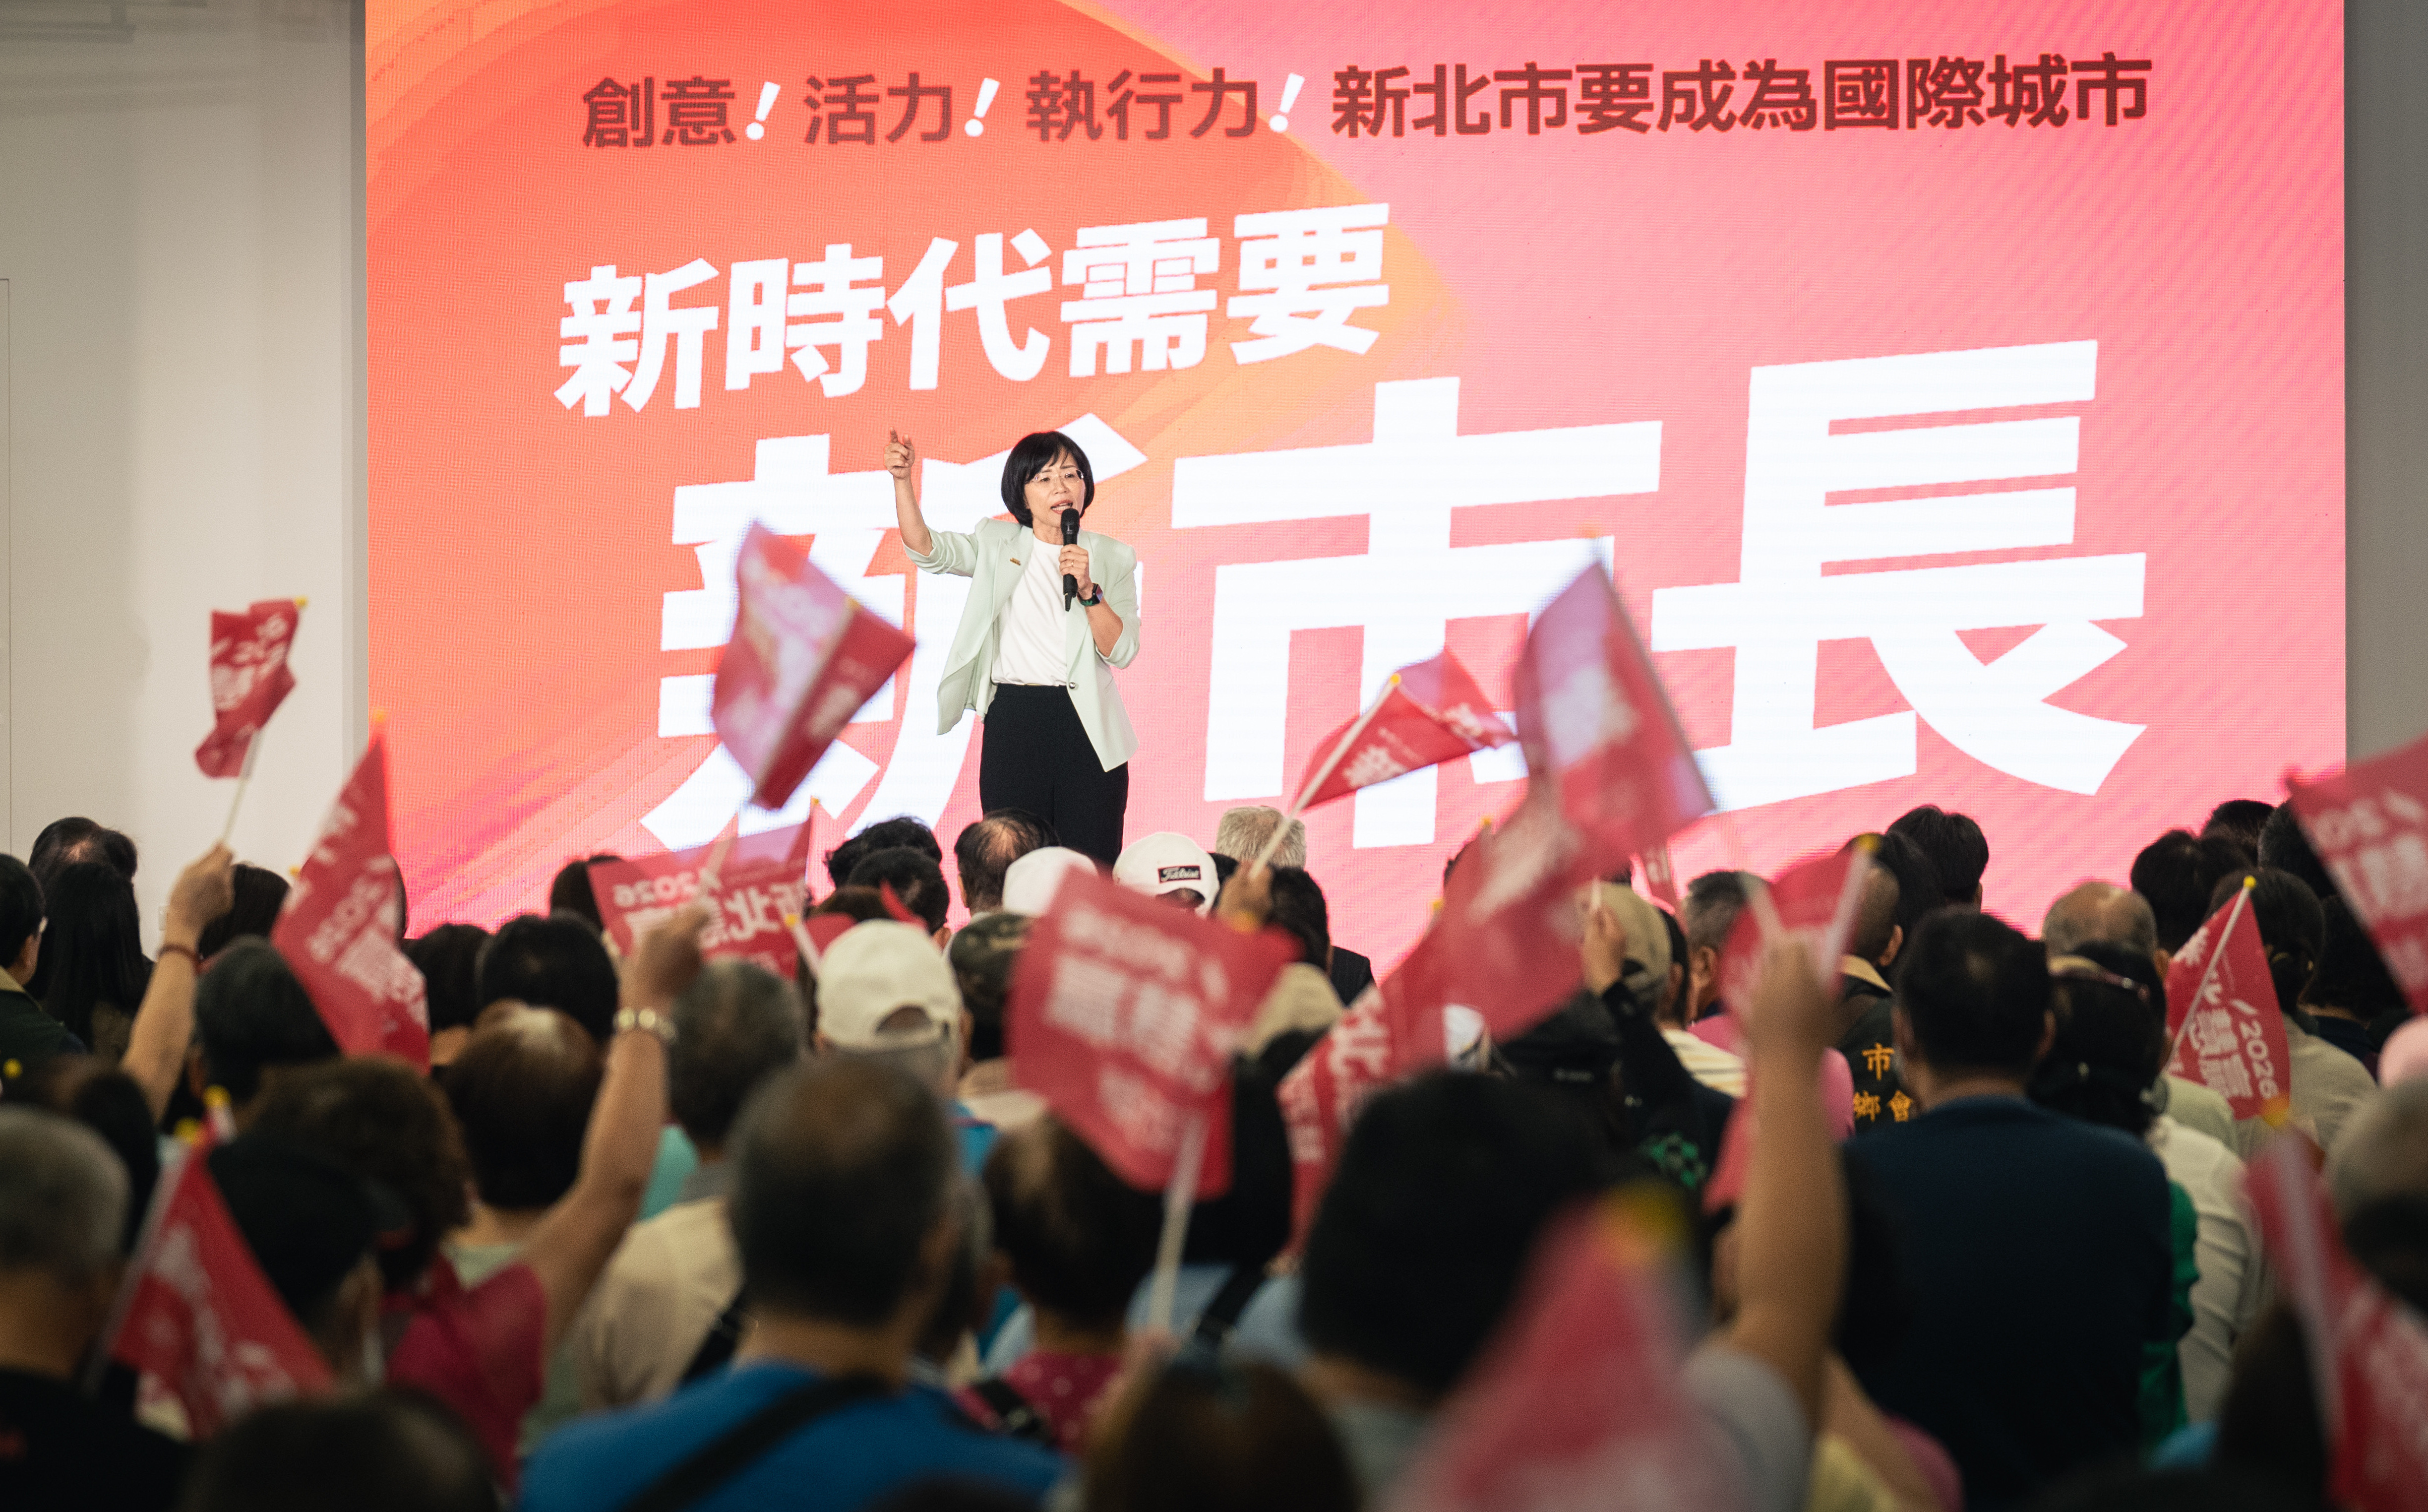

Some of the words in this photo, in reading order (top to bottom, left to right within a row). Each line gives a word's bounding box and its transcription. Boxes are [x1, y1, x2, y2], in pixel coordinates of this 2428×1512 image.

[1331, 52, 2153, 139] 新北市要成為國際城市
[554, 203, 1390, 418] 新時代需要
[1861, 1042, 1895, 1081] 市
